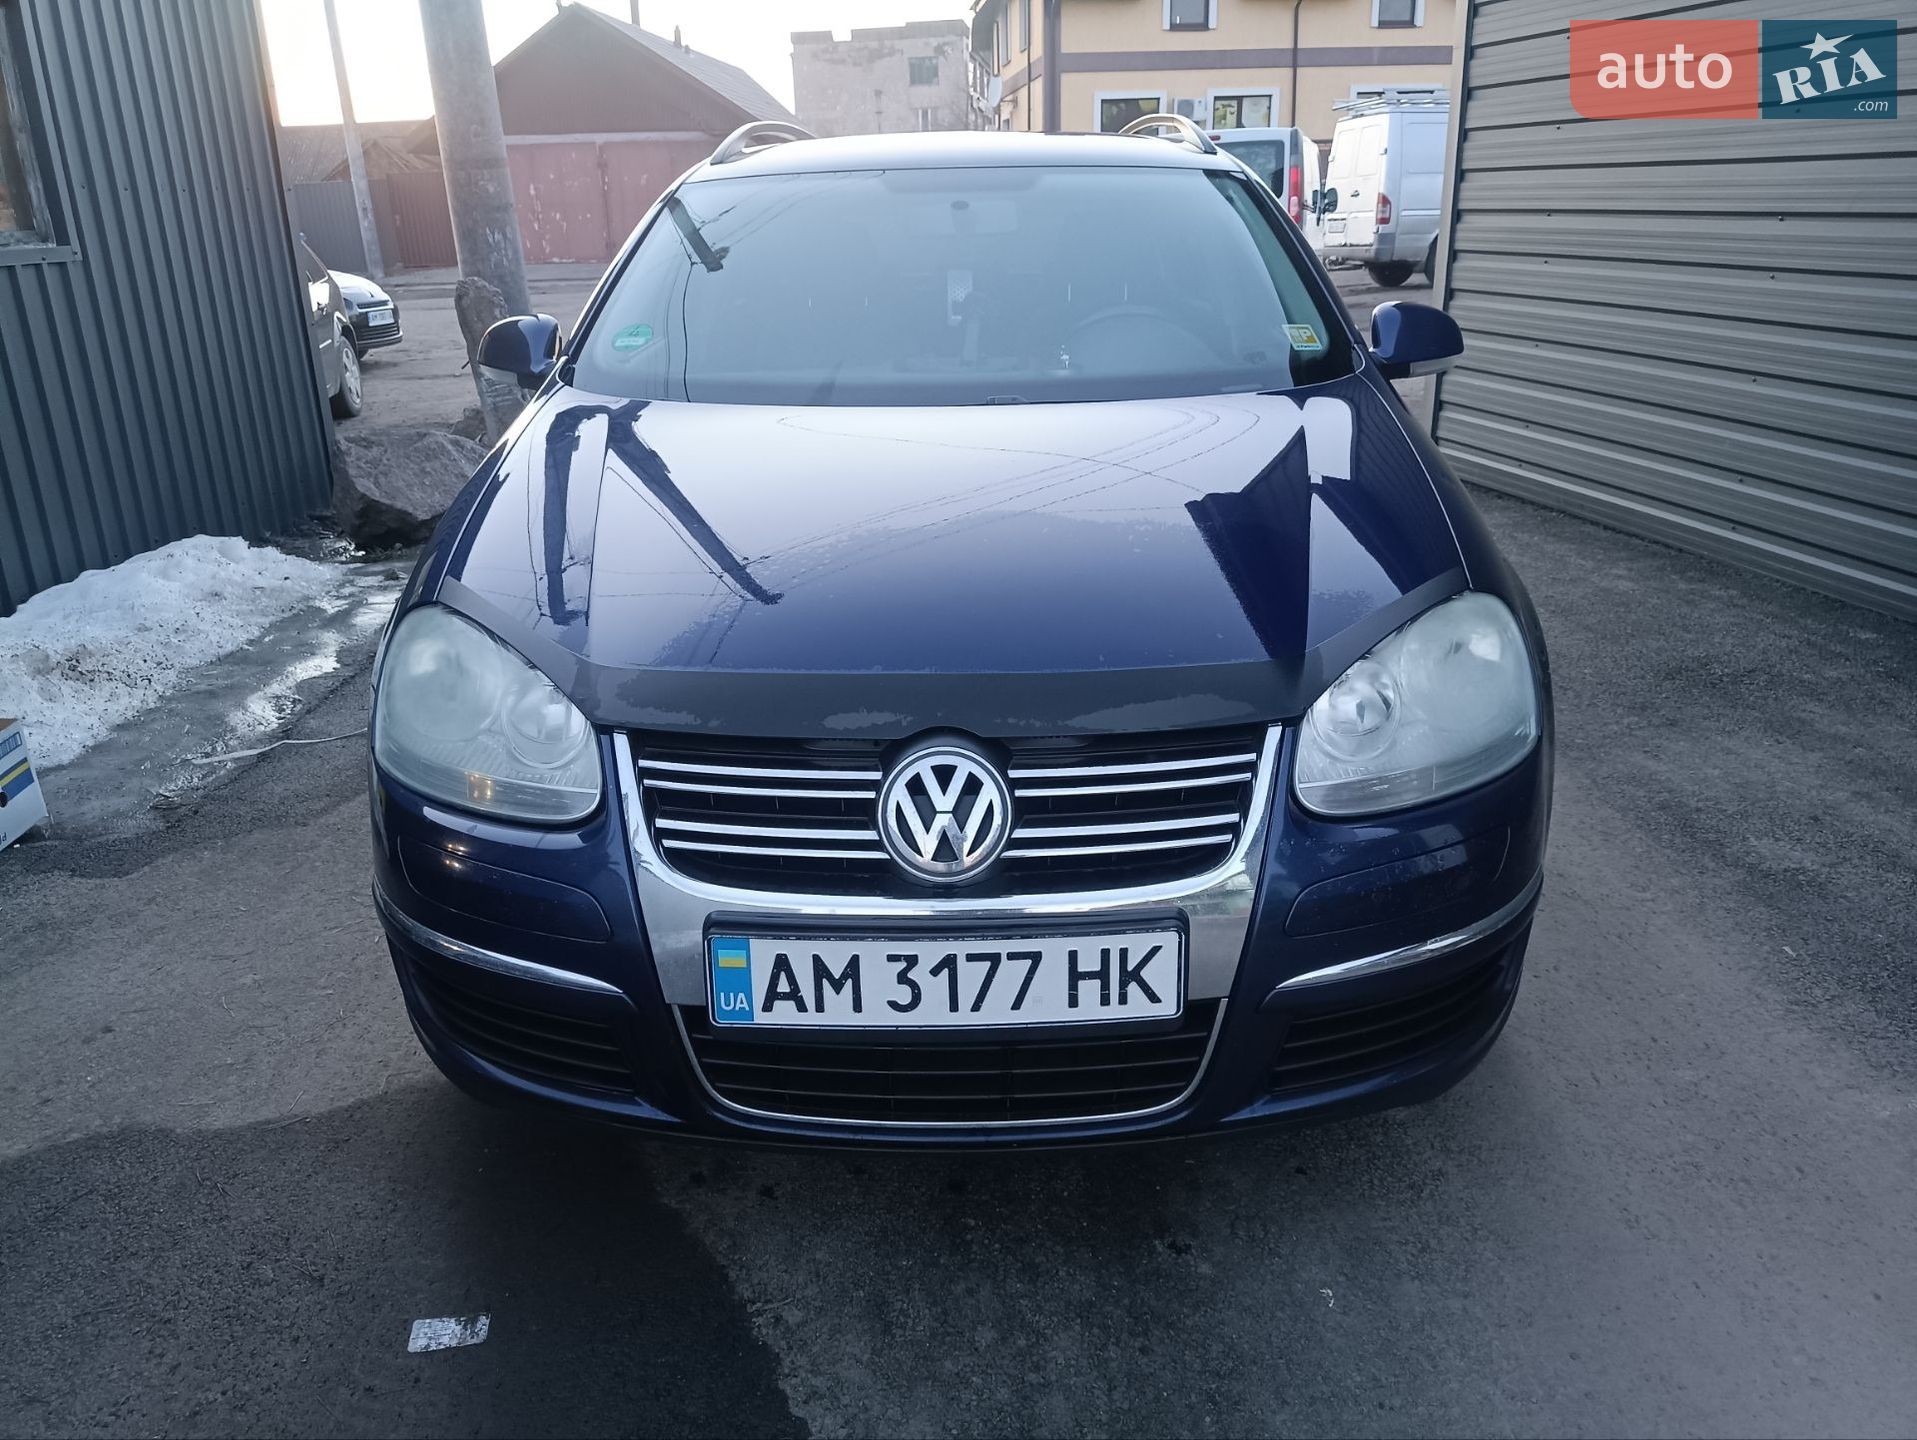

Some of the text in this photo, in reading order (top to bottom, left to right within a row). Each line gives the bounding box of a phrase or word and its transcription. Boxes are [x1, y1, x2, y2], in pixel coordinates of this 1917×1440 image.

[887, 754, 1003, 873] VW
[720, 991, 750, 1011] UA
[761, 944, 1164, 1014] AM 3177 HK
